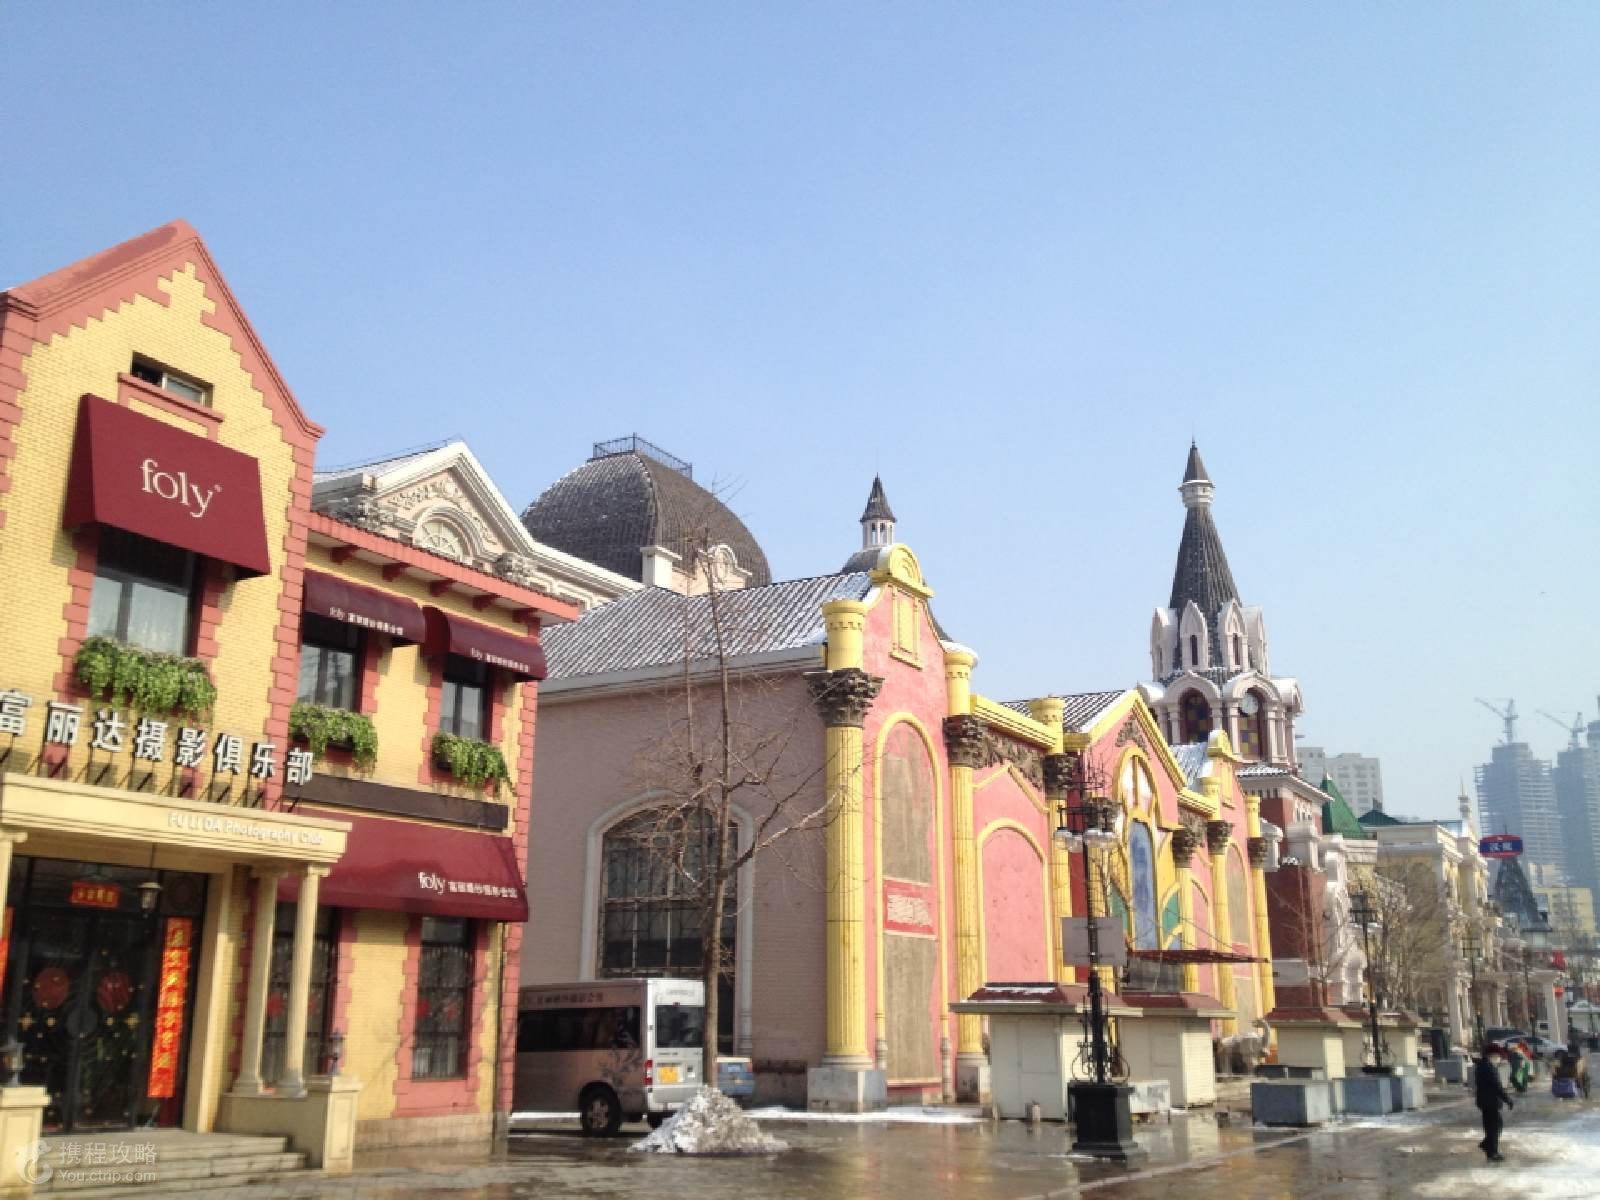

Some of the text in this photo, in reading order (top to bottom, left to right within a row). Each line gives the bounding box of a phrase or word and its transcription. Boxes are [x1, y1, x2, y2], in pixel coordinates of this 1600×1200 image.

[140, 459, 213, 518] foly
[0, 690, 313, 786] 富丽达摄影俱乐部
